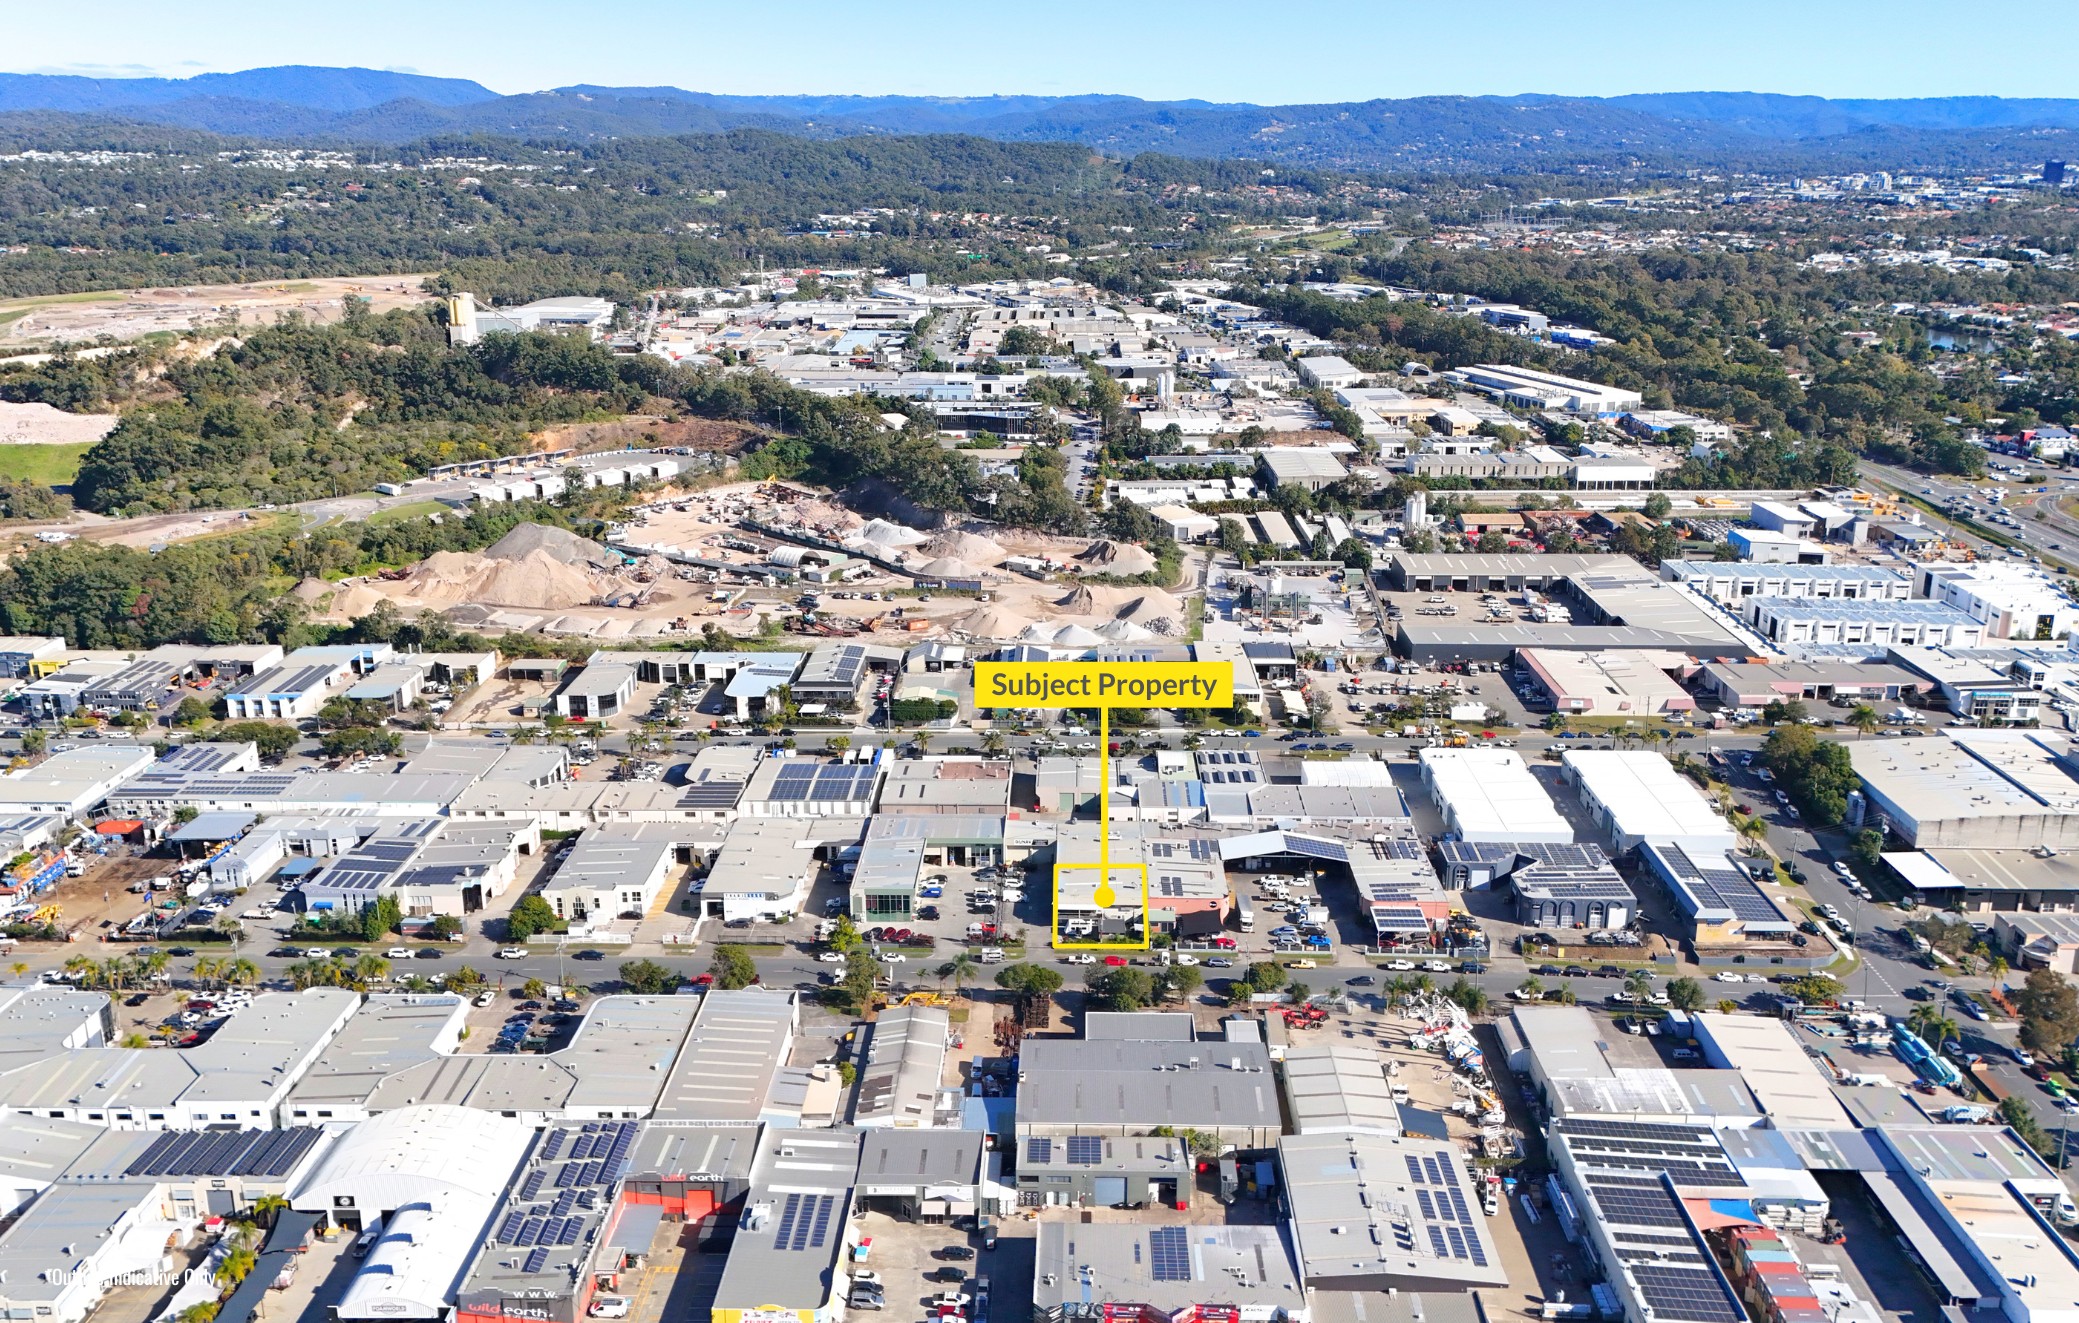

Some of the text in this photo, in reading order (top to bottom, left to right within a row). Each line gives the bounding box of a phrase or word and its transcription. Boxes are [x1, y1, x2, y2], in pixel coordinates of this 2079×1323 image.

[689, 1173, 724, 1182] earth
[468, 1302, 501, 1313] wild
[503, 1306, 548, 1318] earth
